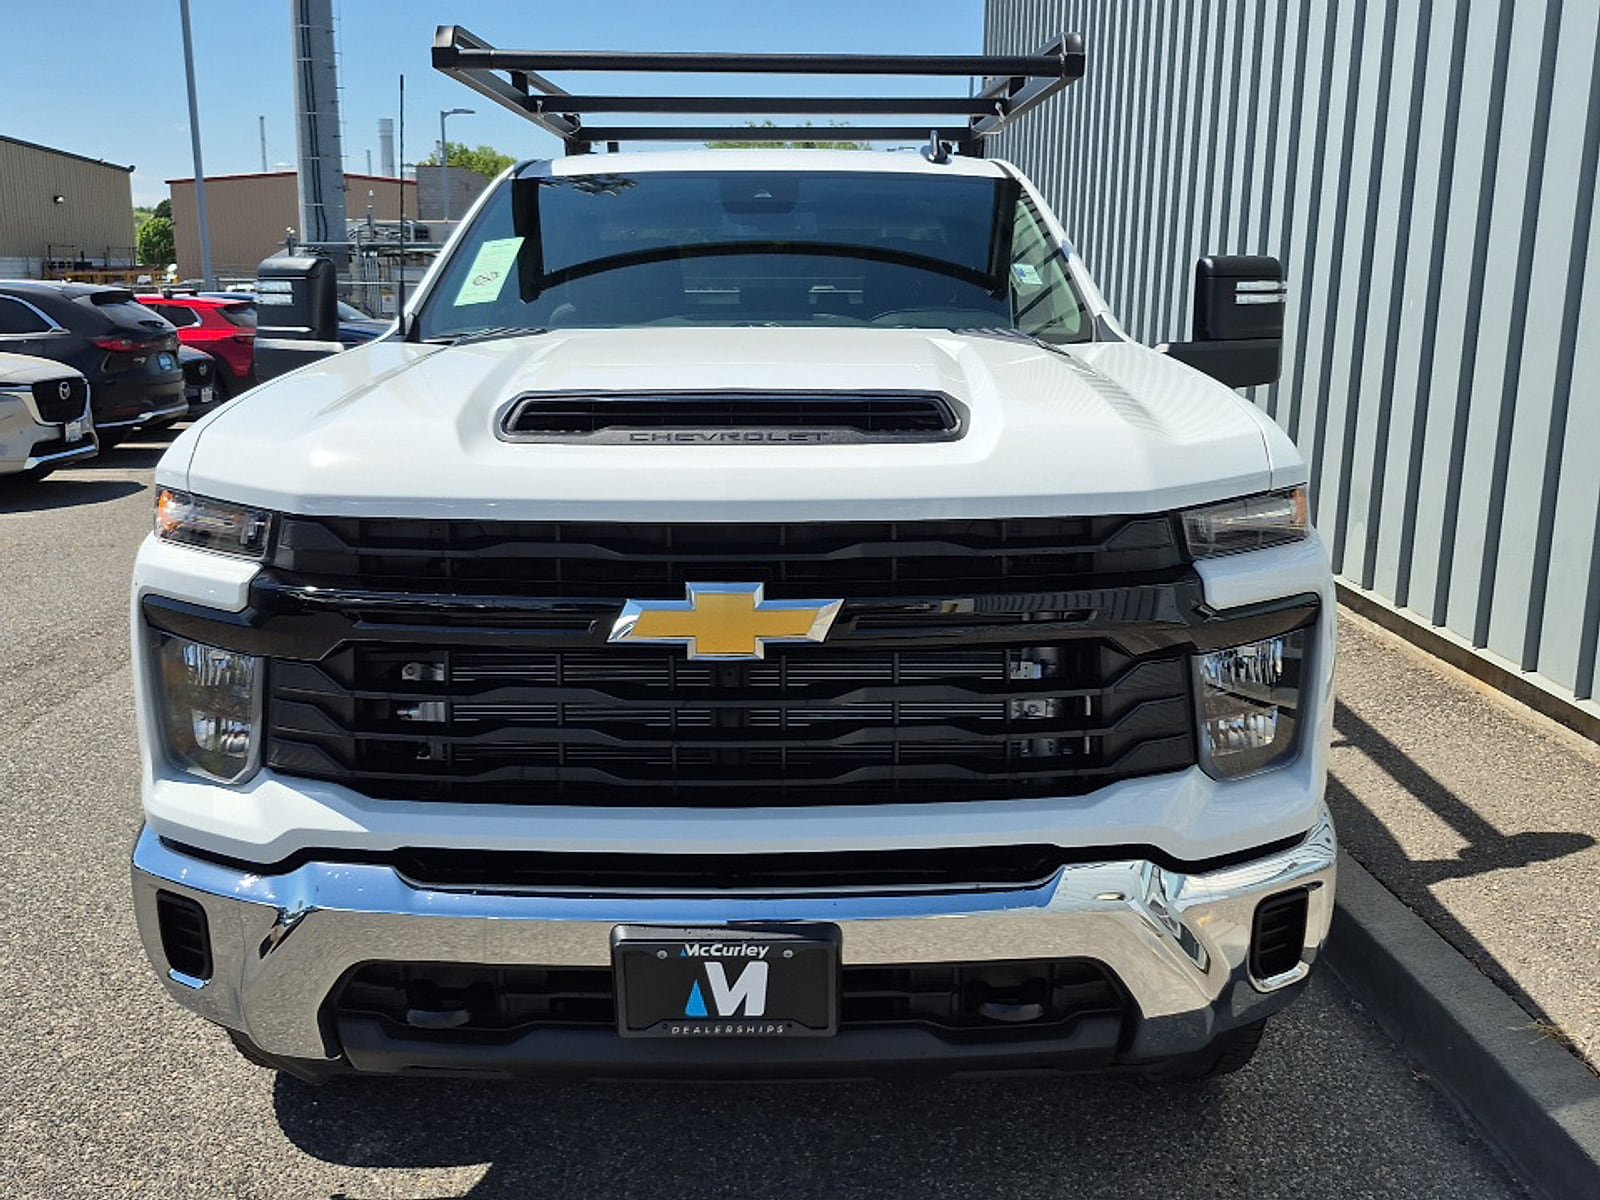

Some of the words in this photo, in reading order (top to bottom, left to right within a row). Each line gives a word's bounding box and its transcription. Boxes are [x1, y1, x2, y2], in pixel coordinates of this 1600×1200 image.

[629, 432, 829, 441] CHEVROLET
[681, 944, 769, 959] McCurley
[671, 1024, 784, 1035] DEALERSHIPS
